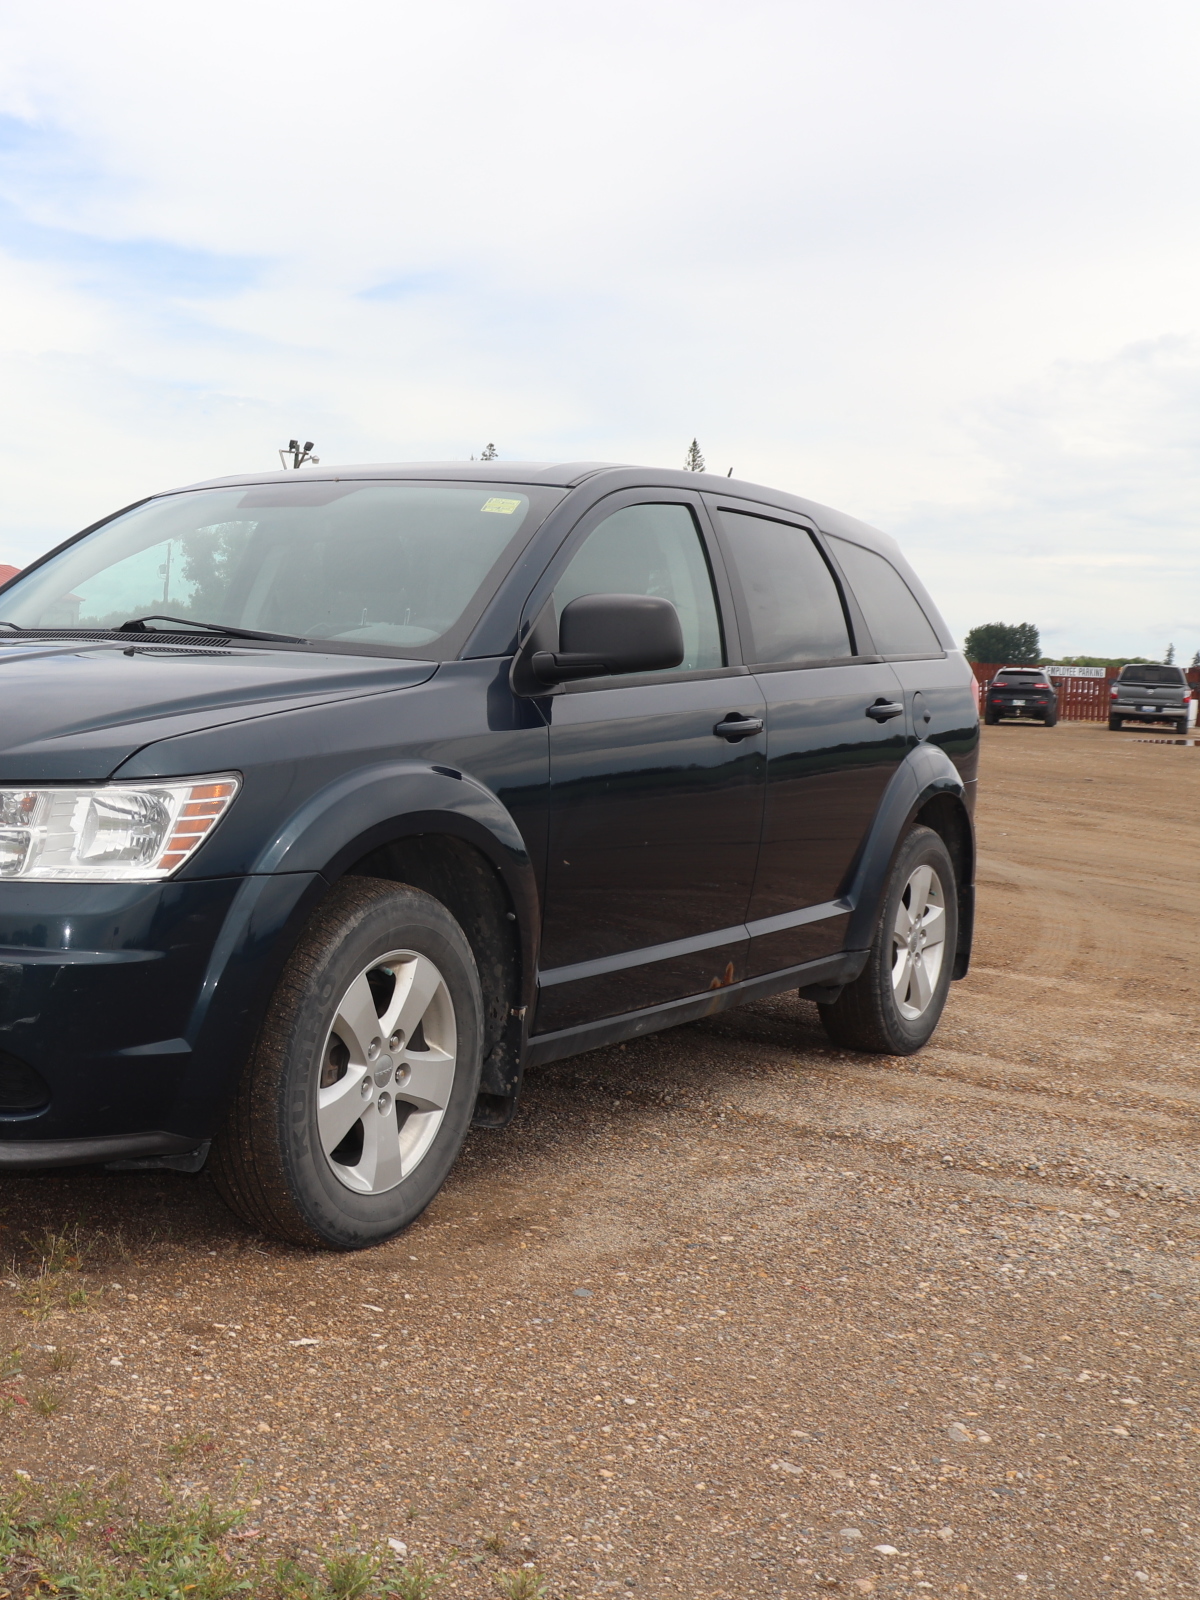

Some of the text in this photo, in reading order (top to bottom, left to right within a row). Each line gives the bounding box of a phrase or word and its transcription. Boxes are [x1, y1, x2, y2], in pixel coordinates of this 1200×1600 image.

[1047, 666, 1104, 677] EMPLOYEE PARKING
[291, 974, 337, 1160] KUMHO
